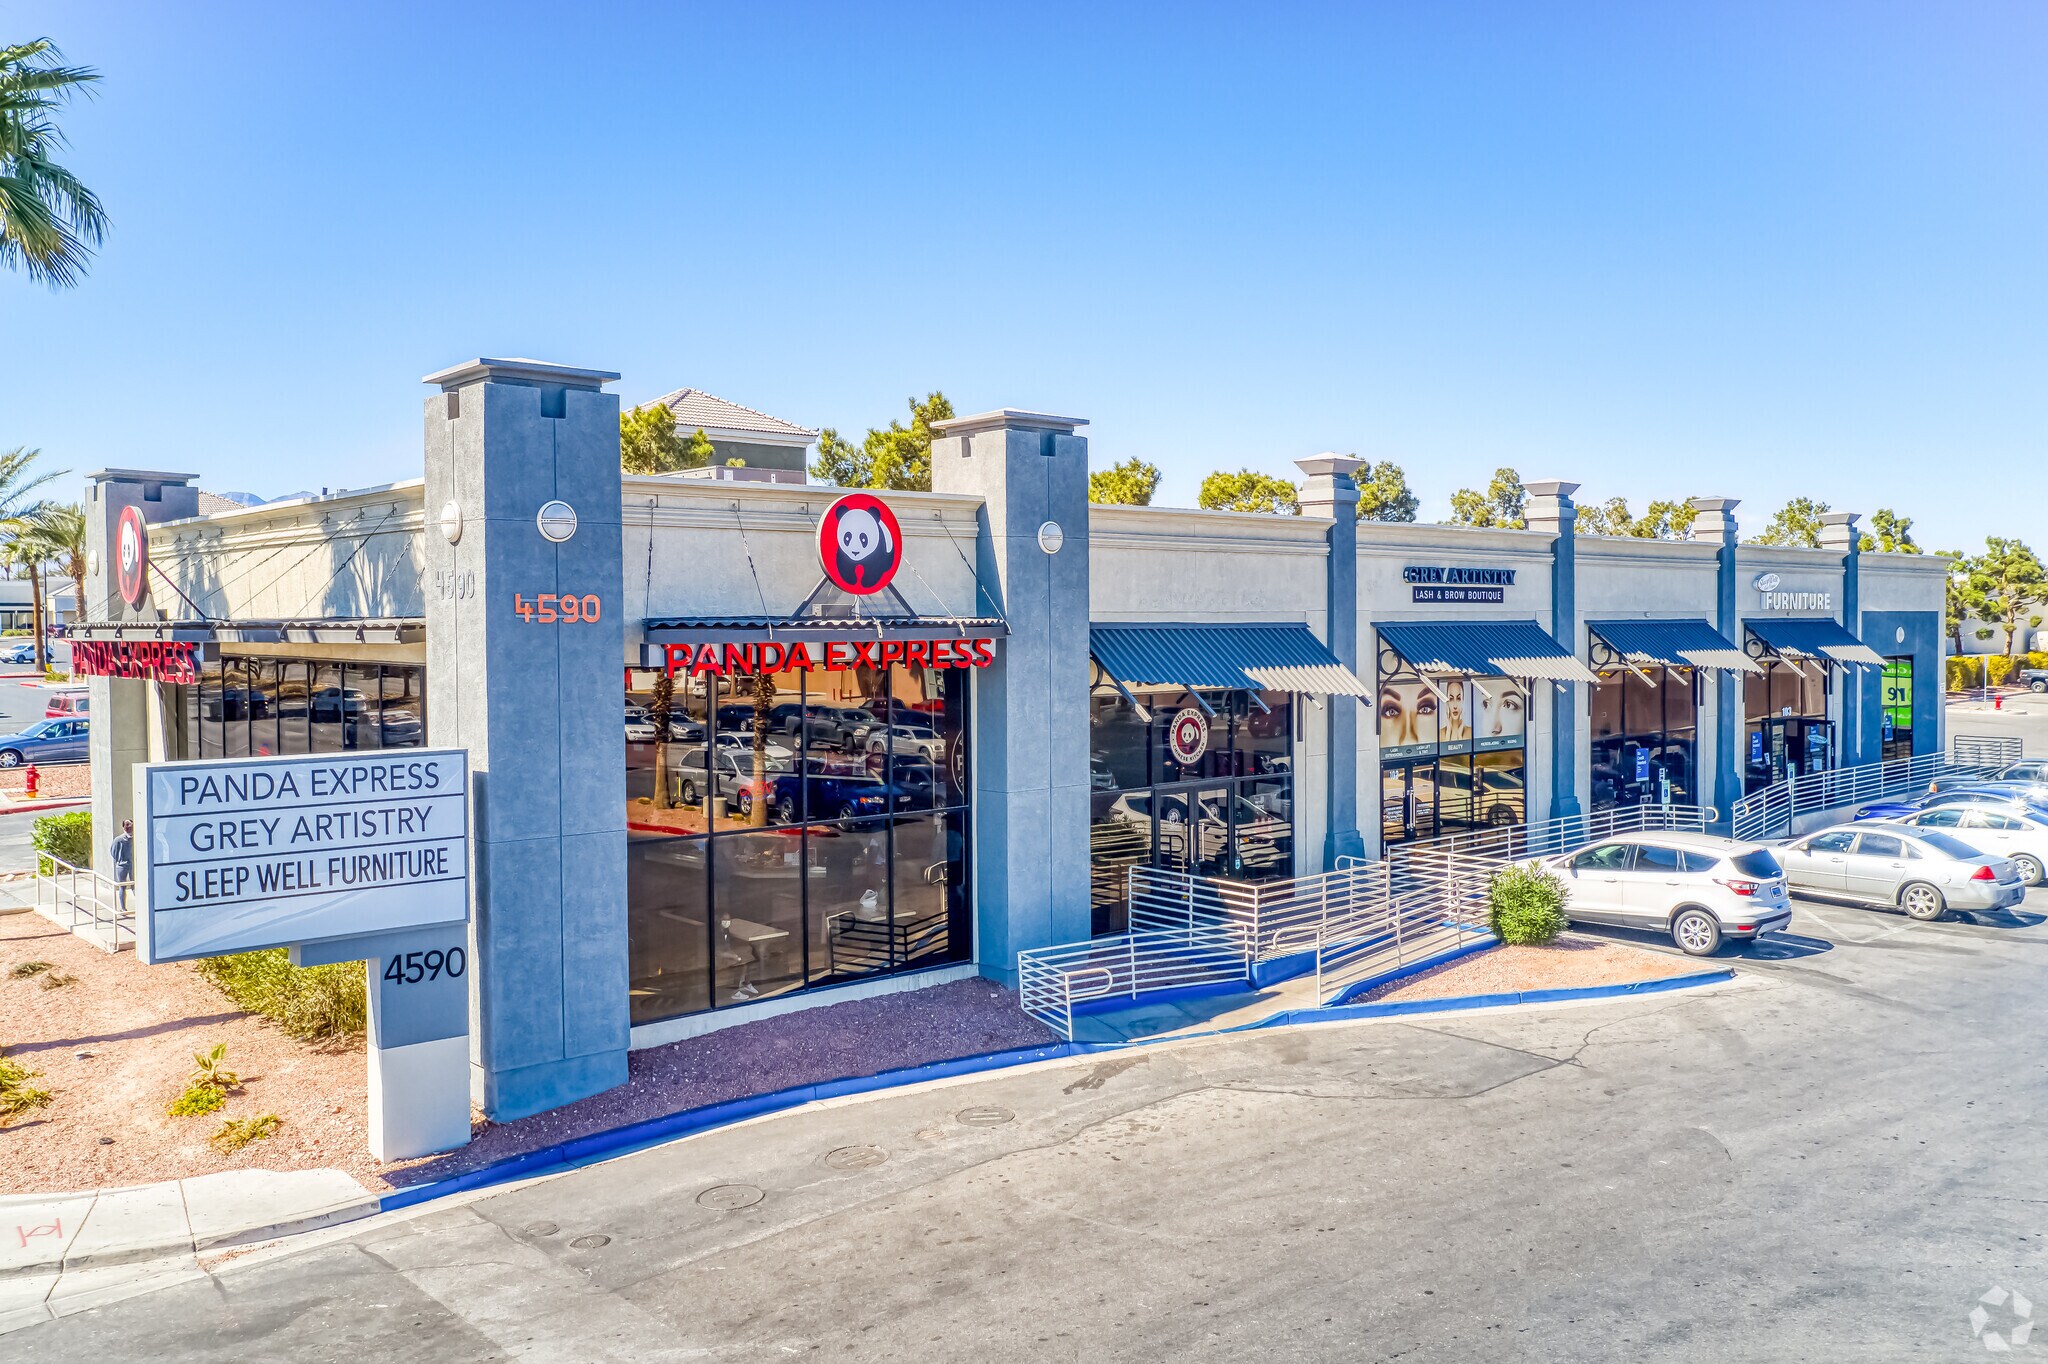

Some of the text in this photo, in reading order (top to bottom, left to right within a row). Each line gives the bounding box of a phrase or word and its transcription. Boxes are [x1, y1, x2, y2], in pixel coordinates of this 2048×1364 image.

[434, 569, 475, 600] 4590
[1404, 566, 1517, 585] GREY ARTISTRY
[1415, 589, 1502, 601] LASH & BROW BOUTIQUE
[514, 593, 601, 624] 4590
[1764, 592, 1831, 610] FURNITURE
[72, 641, 195, 685] PANDA EXPRESS
[664, 638, 993, 679] PANDA EXPRESS
[181, 762, 440, 805] PANDA EXPRESS
[190, 806, 433, 852] GREY ARTISTRY
[175, 847, 449, 902] SLEEP WELL FURNITURE
[383, 946, 466, 985] 4590
